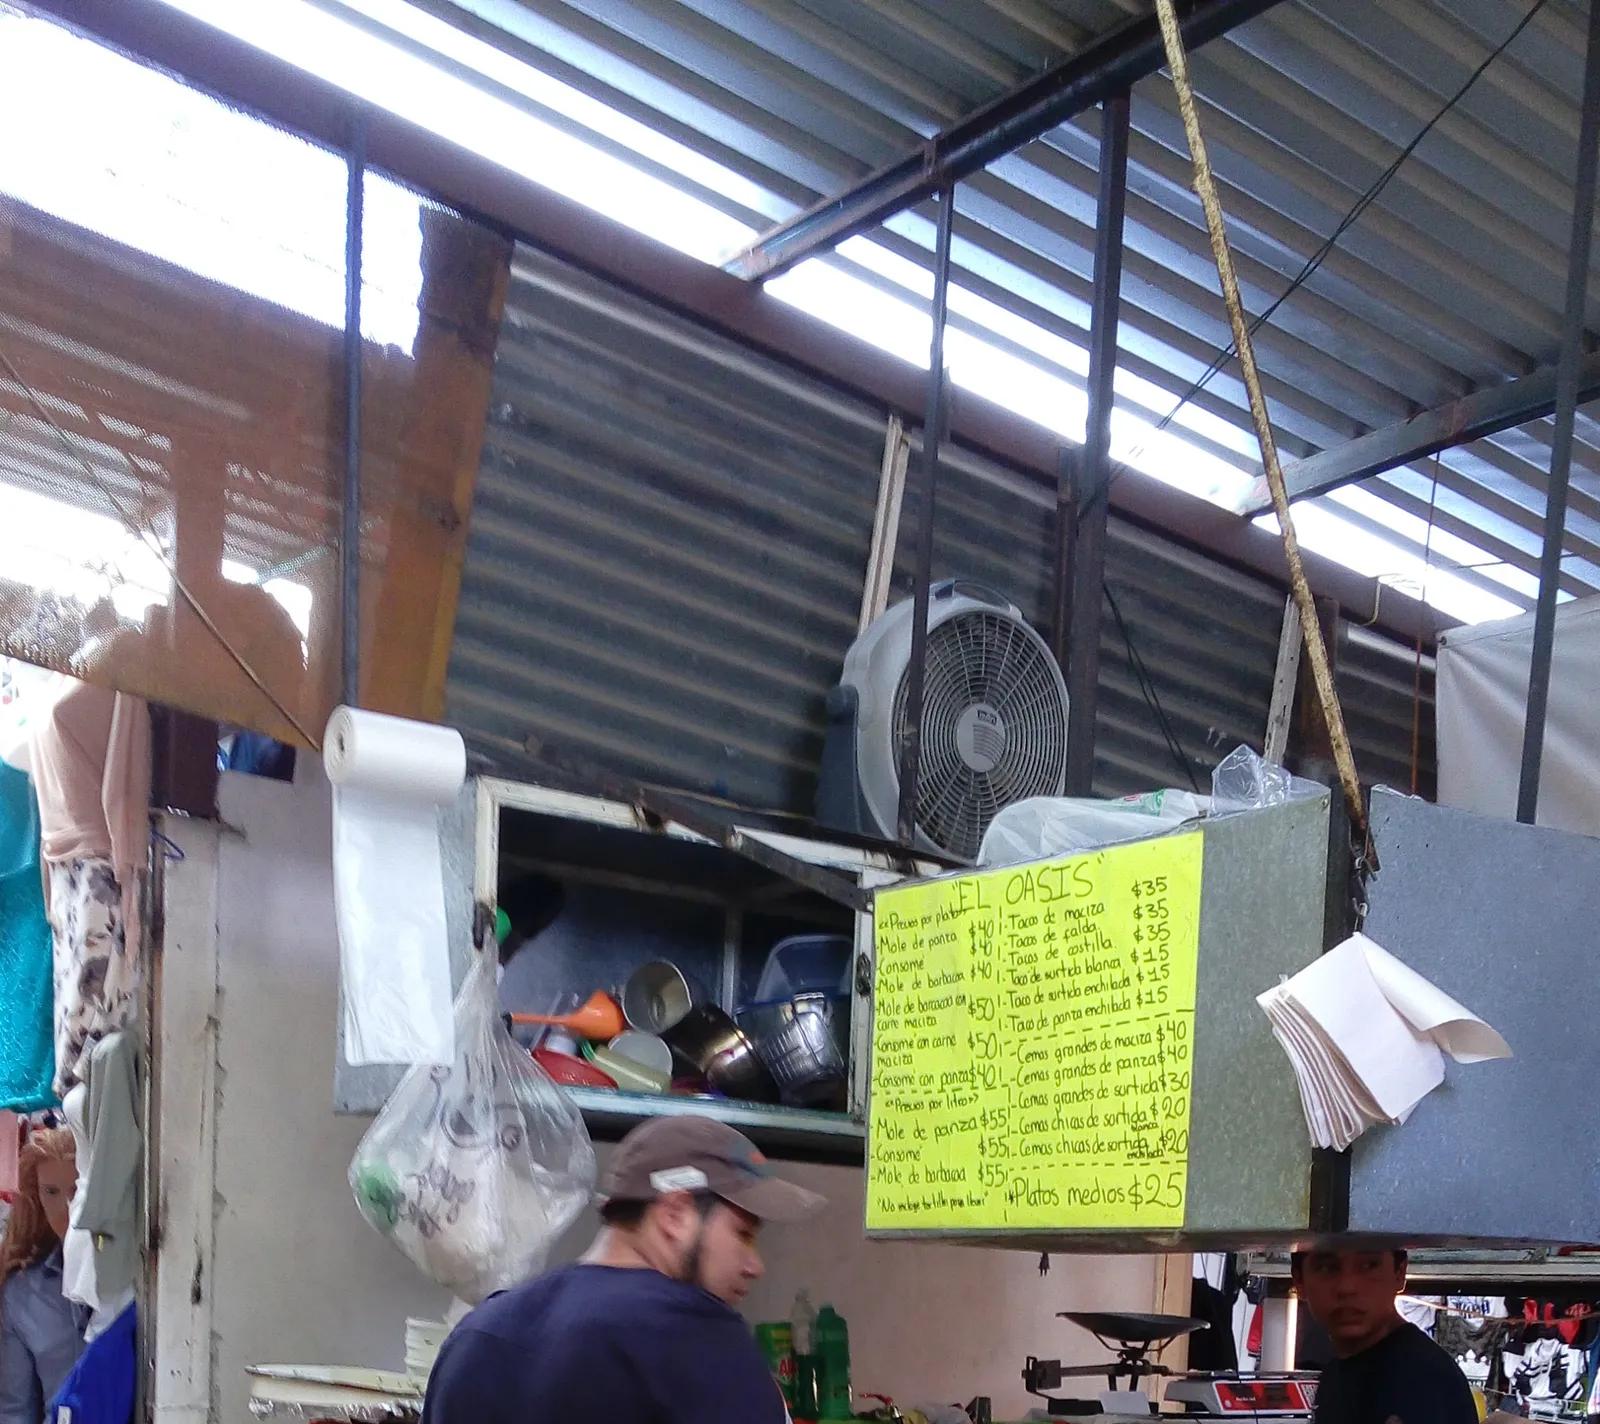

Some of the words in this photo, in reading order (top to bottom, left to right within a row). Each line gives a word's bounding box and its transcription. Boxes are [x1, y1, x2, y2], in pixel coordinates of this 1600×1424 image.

[1043, 906, 1057, 925] de
[1064, 902, 1106, 922] maciza
[1131, 876, 1168, 899] $35
[913, 932, 925, 950] de
[968, 919, 995, 940] $40
[921, 915, 933, 931] por
[1043, 927, 1057, 944] de
[1133, 898, 1170, 921] $35
[969, 940, 993, 957] $40
[1044, 945, 1059, 960] de
[1133, 921, 1171, 944] $35
[911, 971, 922, 990] de
[970, 961, 993, 982] $40
[1029, 964, 1042, 983] de
[1130, 943, 1170, 965] $15
[1033, 983, 1045, 1004] de
[1135, 963, 1171, 985] $15
[903, 994, 915, 1015] de
[967, 995, 996, 1021] $50
[1036, 1008, 1050, 1031] de
[1053, 1008, 1083, 1032] panza
[1135, 985, 1169, 1010] $15
[967, 1030, 998, 1060] $50
[1054, 1033, 1098, 1064] grandes
[1099, 1032, 1113, 1050] de
[1114, 1032, 1153, 1048] maciza
[1156, 1019, 1188, 1045] $40
[877, 1054, 914, 1068] maciza
[919, 1073, 935, 1087] con
[940, 1070, 969, 1092] panza
[968, 1059, 997, 1088] $40
[1053, 1056, 1097, 1087] grandes
[1099, 1054, 1112, 1073] de
[1116, 1054, 1157, 1076] panza
[1156, 1044, 1188, 1065] $40
[928, 1099, 944, 1113] por
[1053, 1080, 1095, 1112] grandes
[1096, 1079, 1109, 1099] de
[1157, 1070, 1190, 1093] $30
[912, 1116, 929, 1141] de
[933, 1116, 978, 1144] panza
[979, 1106, 1008, 1131] $55
[1051, 1106, 1085, 1131] chicas
[1086, 1103, 1100, 1128] de
[1149, 1095, 1187, 1121] $20
[978, 1133, 1007, 1159] $55
[1056, 1133, 1091, 1156] chicas
[1092, 1131, 1105, 1155] de
[1159, 1127, 1188, 1154] $20
[908, 1163, 920, 1185] de
[977, 1159, 1005, 1188] $55
[1068, 1176, 1126, 1207] medios
[1127, 1171, 1184, 1212] $25
